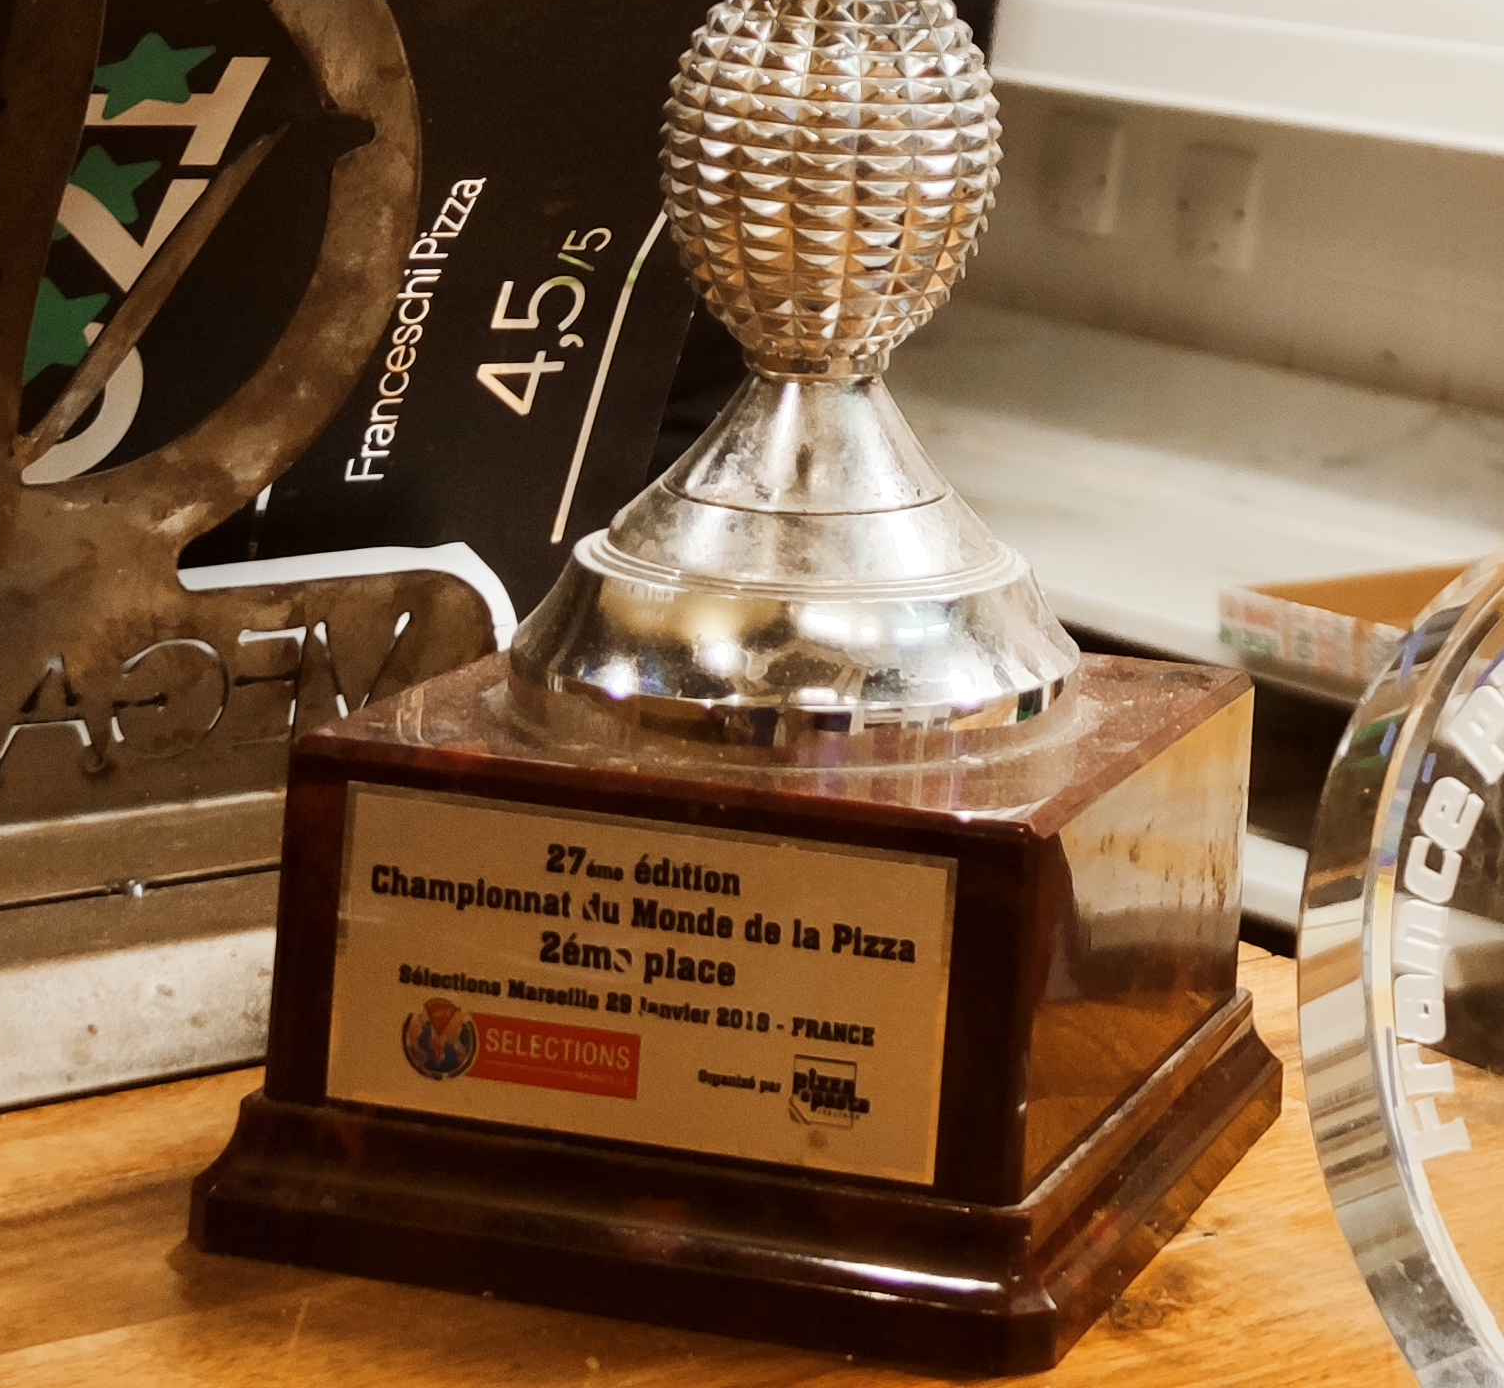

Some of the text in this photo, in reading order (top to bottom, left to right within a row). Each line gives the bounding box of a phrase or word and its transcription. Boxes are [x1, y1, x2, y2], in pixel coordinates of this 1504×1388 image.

[345, 176, 486, 483] Franceschi Pizza
[634, 853, 740, 896] édition
[371, 864, 916, 963] Championnat du Monde de la Pizza
[643, 947, 736, 986] place
[1392, 773, 1484, 1162] France
[399, 963, 501, 997] Sélections
[507, 978, 599, 1009] Marseille
[791, 1016, 875, 1047] FRANCE
[485, 1027, 631, 1071] SELECTIONS
[759, 1080, 781, 1094] par
